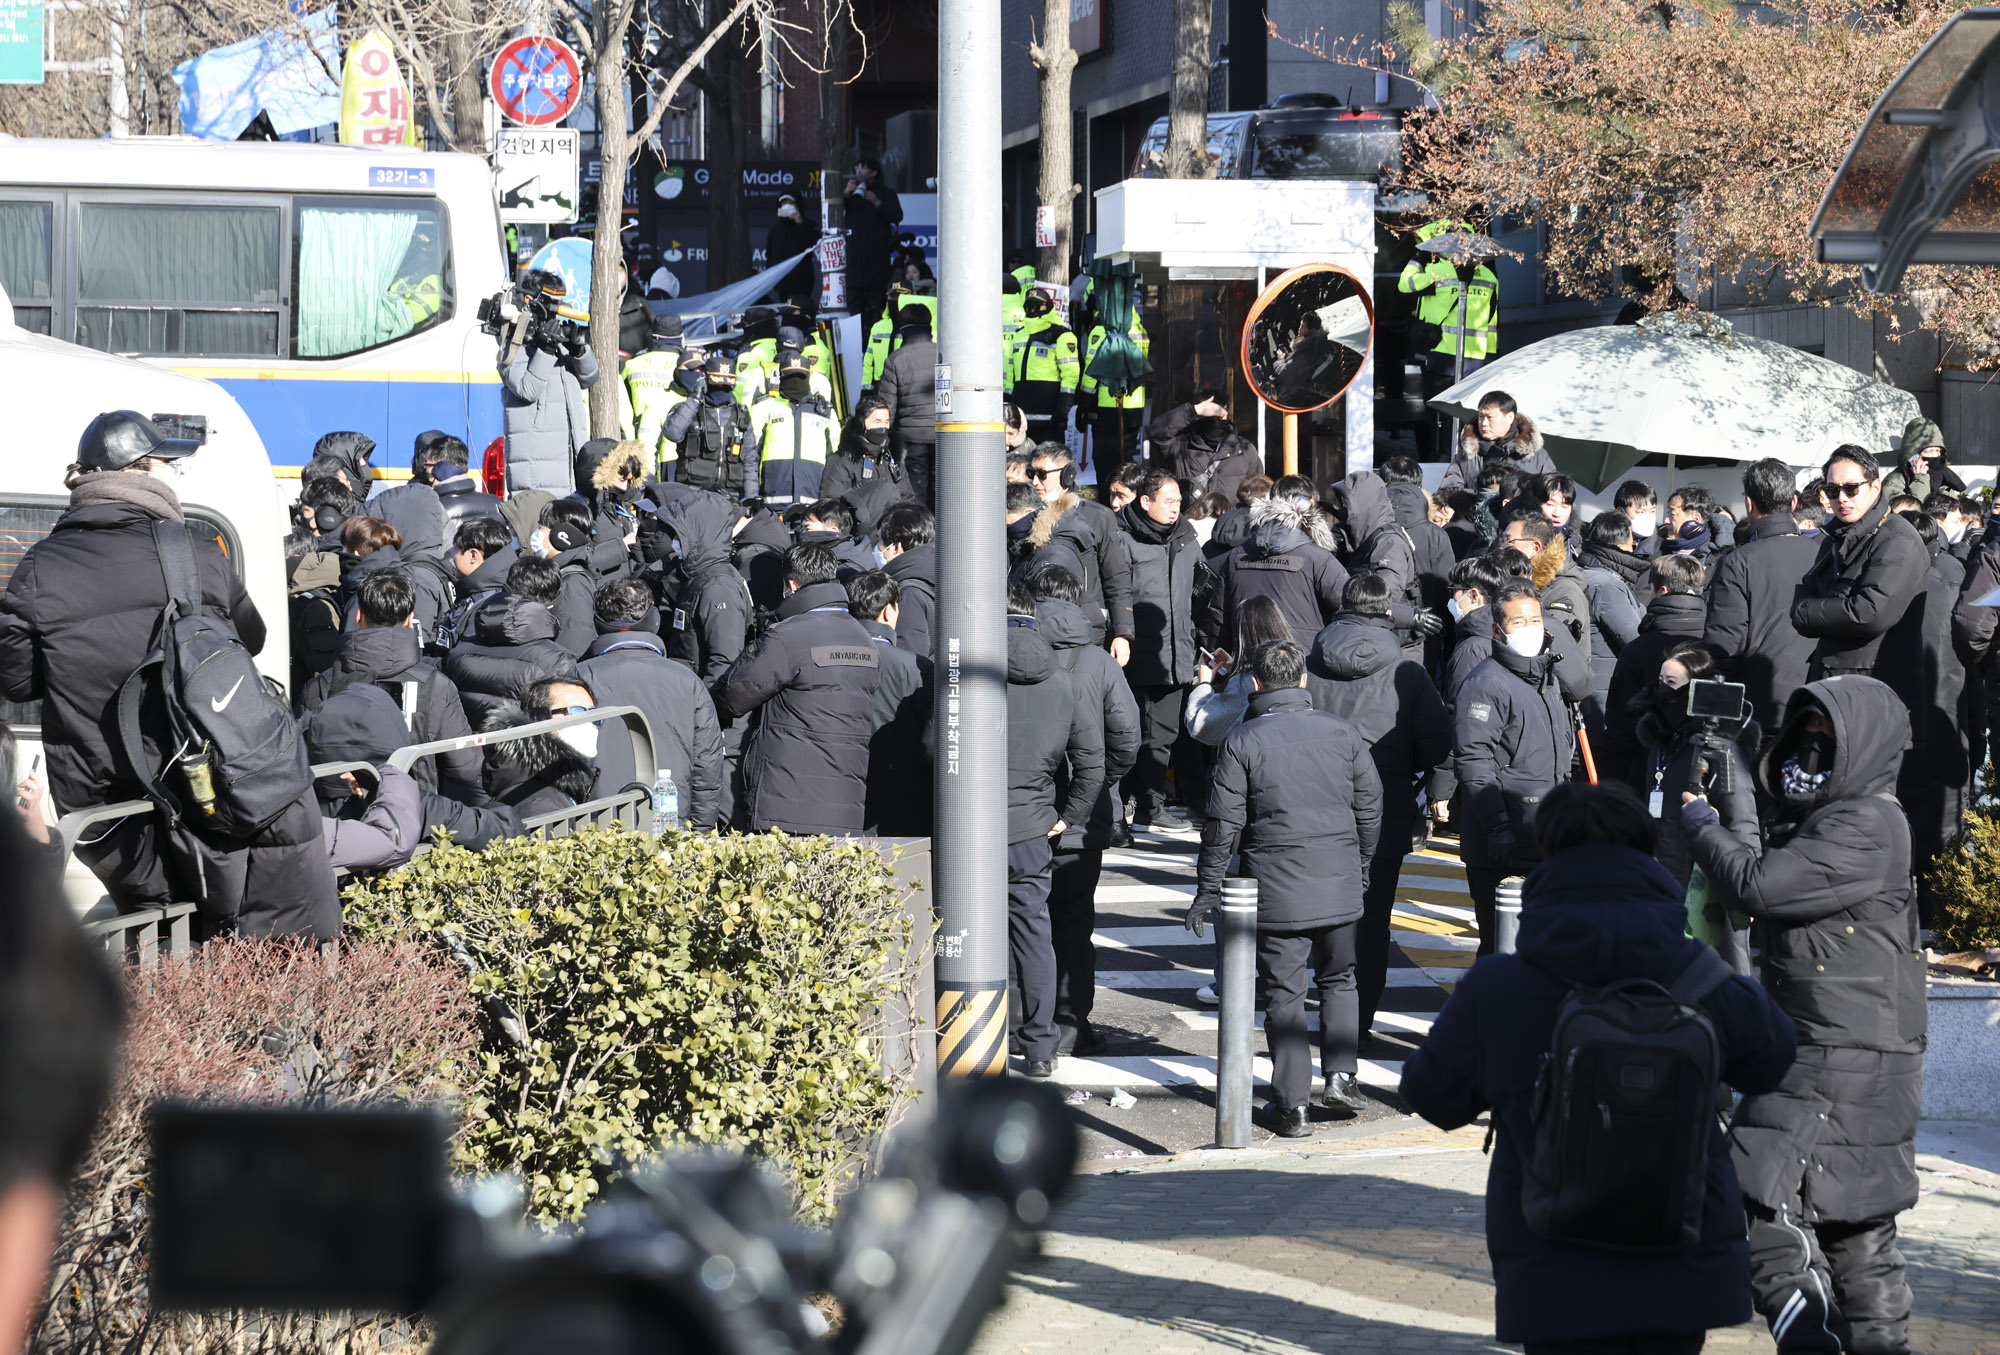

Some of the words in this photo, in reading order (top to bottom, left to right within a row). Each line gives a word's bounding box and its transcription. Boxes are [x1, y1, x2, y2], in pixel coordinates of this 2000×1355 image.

[503, 73, 569, 89] 주정차금지
[501, 137, 572, 155] 견인지역
[376, 168, 428, 185] 32기-3
[742, 169, 794, 185] Made
[1451, 287, 1488, 297] PLICE
[829, 651, 872, 662] ANTARCTICA
[947, 637, 961, 776] 불법광고물부착금지
[945, 946, 963, 958] 용산
